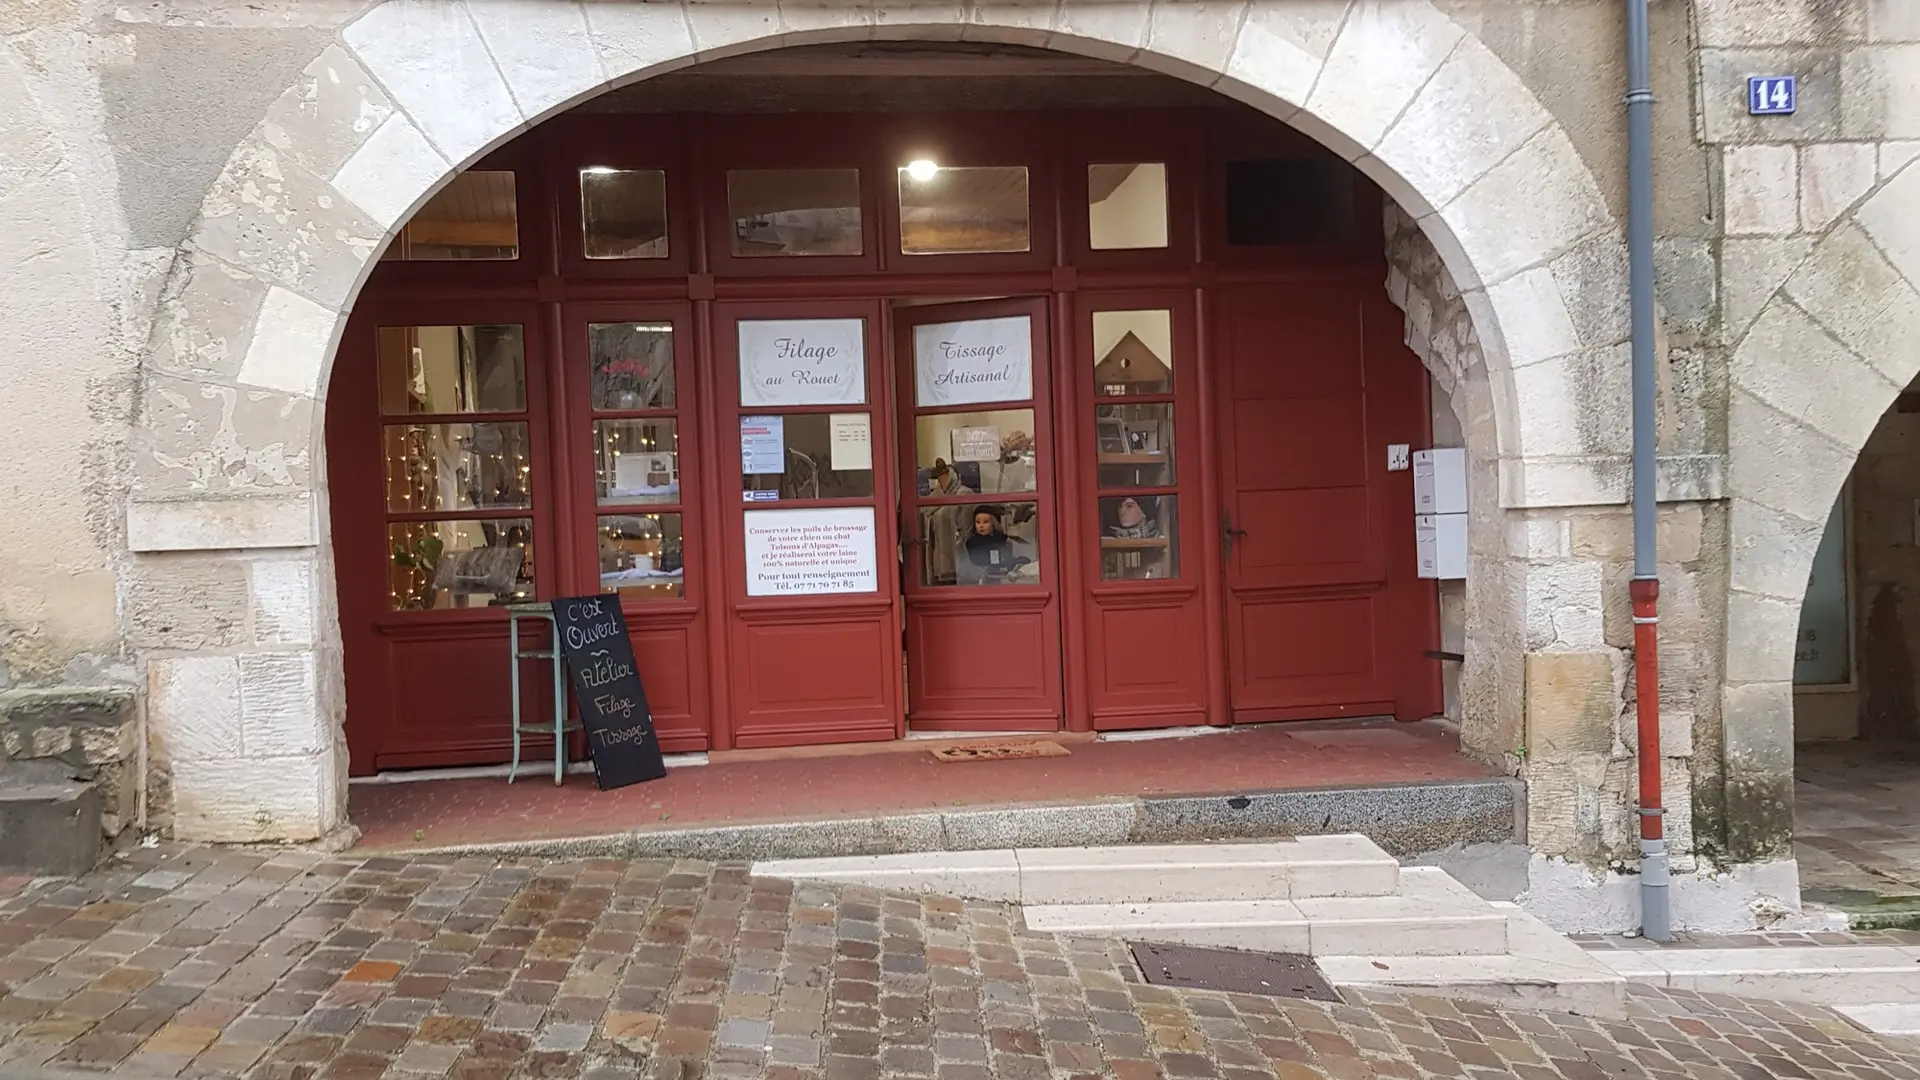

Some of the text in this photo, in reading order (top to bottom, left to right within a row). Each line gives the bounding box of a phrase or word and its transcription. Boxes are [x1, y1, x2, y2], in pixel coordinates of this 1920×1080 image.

[1756, 79, 1789, 110] 14
[774, 338, 838, 365] Filage
[939, 341, 1007, 362] Tissage
[765, 375, 784, 386] au
[791, 370, 841, 385] Rouet
[934, 364, 1011, 385] Artisanal
[749, 527, 789, 535] Conservez
[803, 525, 822, 534] poils
[823, 524, 833, 532] de
[833, 524, 868, 532] brossage
[769, 552, 778, 560] je
[779, 551, 815, 559] réaliserai
[771, 543, 801, 551] Toisons
[763, 560, 784, 568] 100%
[785, 559, 820, 567] naturelle
[830, 558, 857, 566] unique
[758, 570, 870, 581] Pour tout renseignement
[775, 582, 792, 590] Tél.
[831, 581, 840, 589] 71
[842, 580, 854, 588] 85
[567, 598, 604, 622] C'est
[566, 613, 620, 650] Ouvert
[581, 658, 634, 689] Atelier
[594, 693, 636, 718] Filage
[593, 724, 648, 748] Tissage
